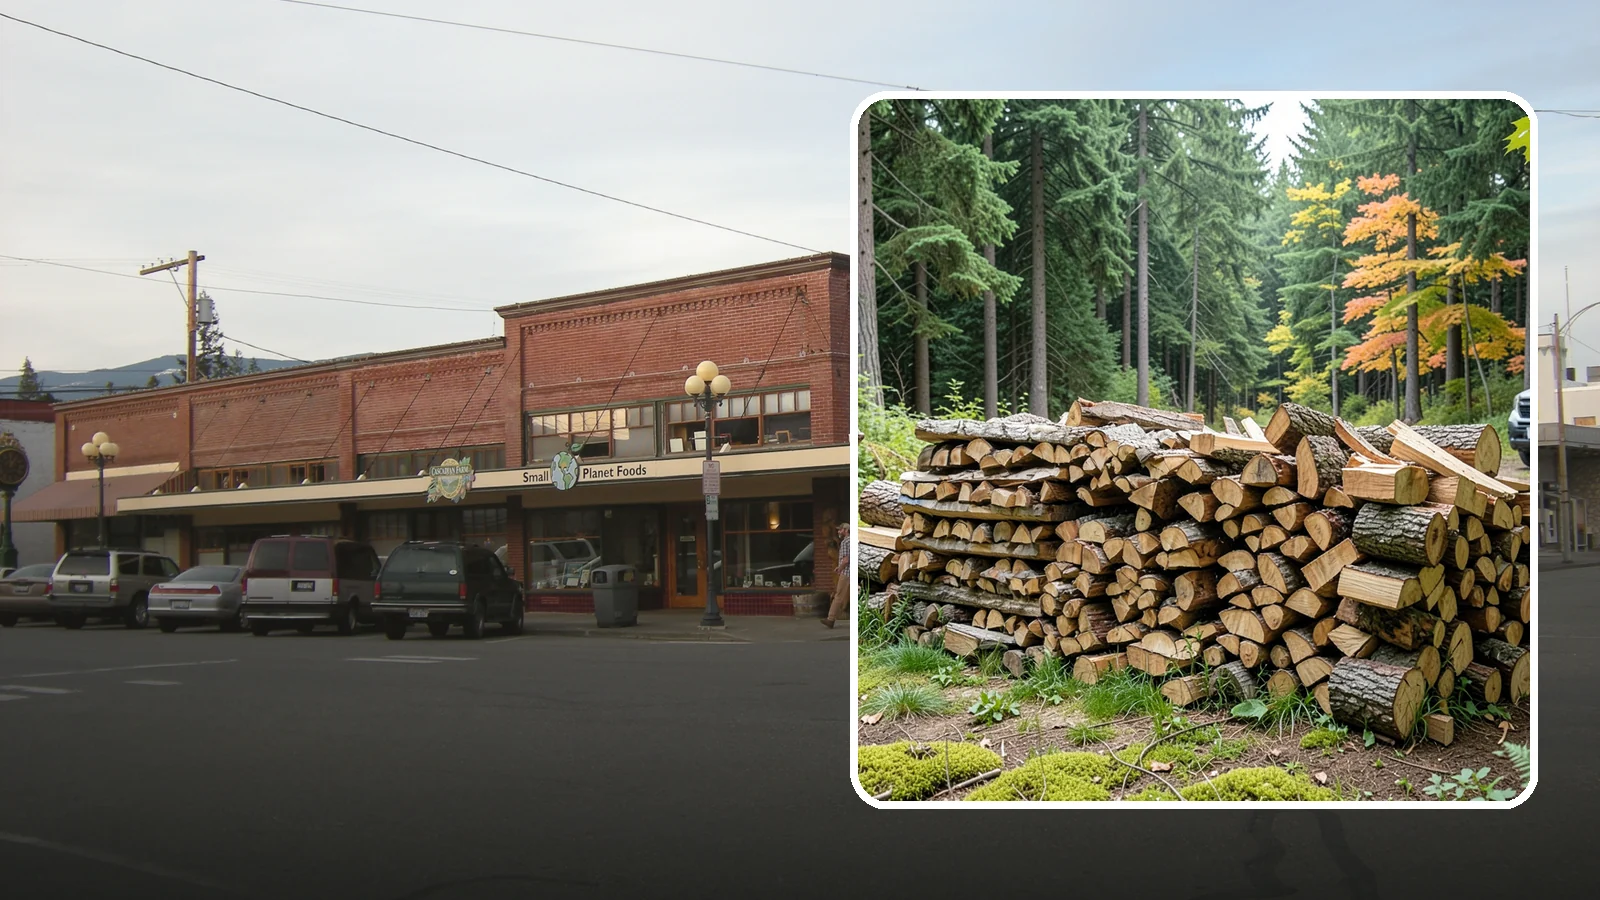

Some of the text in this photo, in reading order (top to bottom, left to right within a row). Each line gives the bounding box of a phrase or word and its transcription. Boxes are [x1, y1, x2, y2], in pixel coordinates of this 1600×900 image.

[523, 464, 647, 483] Small Planet Foods
